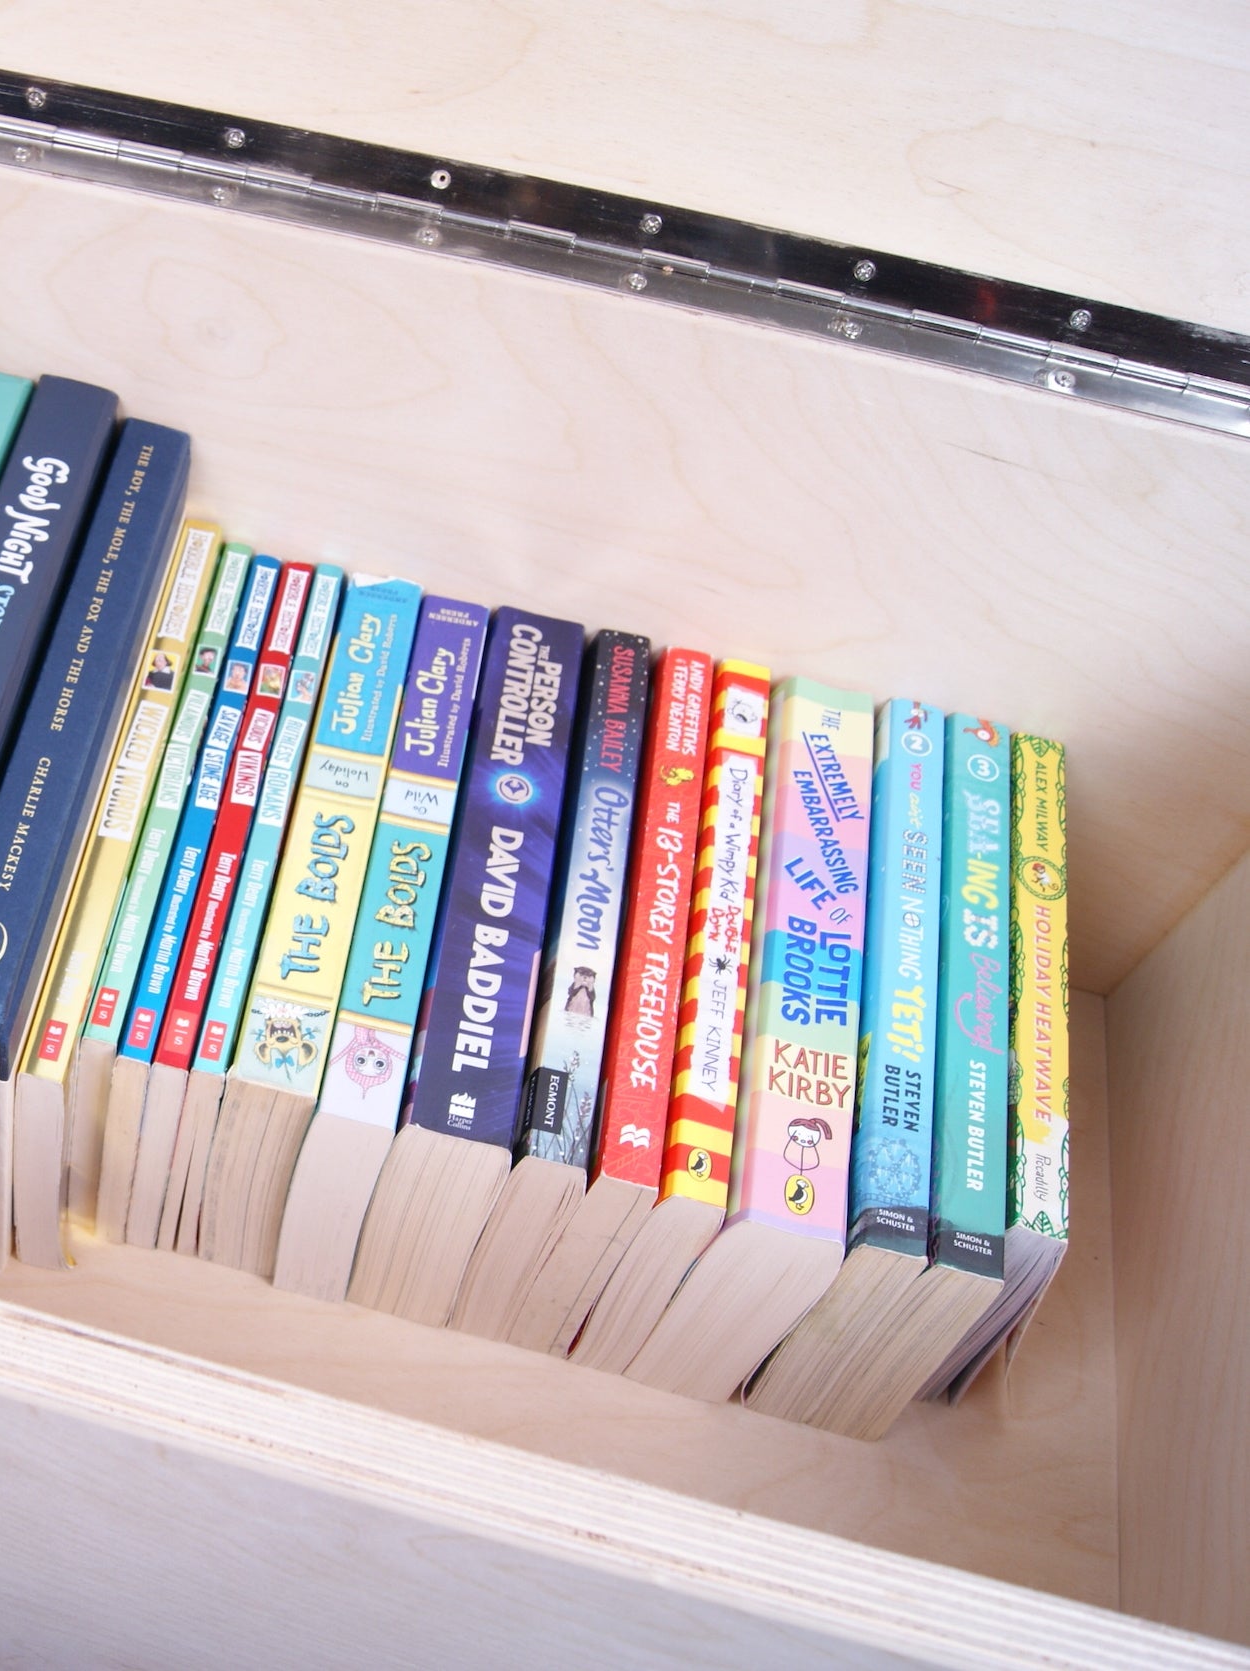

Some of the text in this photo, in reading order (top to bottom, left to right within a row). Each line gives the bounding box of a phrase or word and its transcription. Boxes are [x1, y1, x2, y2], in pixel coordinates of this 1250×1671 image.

[51, 445, 153, 732] THE BOY, THE MOLE, THE FOX AND THE HORSE
[330, 613, 381, 735] Julian Clary
[361, 687, 382, 742] Illustrated
[377, 649, 389, 677] David
[404, 648, 455, 756] Julian Clary
[490, 623, 543, 766] CONTROLLER
[525, 645, 563, 747] THE PERSON
[600, 645, 635, 773] SUSANNA BAILEY
[665, 666, 688, 752] TERRY DENTON
[682, 660, 705, 756] ANDY GRIFFITHS
[125, 707, 164, 760] WICKED
[199, 710, 238, 802] SAVAGE STONE AGE
[437, 713, 457, 768] Illustrated
[452, 674, 465, 704] David
[821, 709, 842, 731] THE
[21, 757, 51, 818] CHARLIE
[235, 755, 259, 797] VIKINGS
[261, 770, 290, 820] ROMANS
[320, 760, 368, 781] Holiday
[405, 789, 438, 806] Wild
[726, 767, 748, 808] Diary
[810, 733, 864, 822] EXTREMELY
[910, 763, 922, 790] YOU
[1035, 760, 1049, 852] ALEX MILWAY
[718, 833, 741, 877] Wimpy
[730, 808, 743, 821] of
[793, 769, 859, 895] EMBARRASSING
[279, 812, 355, 980] THE BOLDS
[719, 878, 739, 903] Kid
[783, 856, 854, 925] LIFE OF
[902, 829, 928, 894] SEEN
[184, 851, 238, 1001] Terry Deary Martin Brown
[362, 840, 432, 1007] THE BOLDS
[451, 826, 524, 1072] DAVID BADDIEL
[577, 869, 612, 950] Moon
[629, 801, 683, 1091] THE 13-STOREY TREEHOUSE
[898, 895, 926, 981] NOTHING
[963, 907, 999, 950] IS
[781, 915, 817, 1026] BROOKS
[815, 931, 852, 1026] LOTTIE
[701, 980, 728, 1092] JEFF KINNEY
[1033, 905, 1052, 1123] HOLIDAY HEATWAVE
[767, 1065, 851, 1110] KIRBY
[774, 1038, 849, 1081] KATIE
[882, 1064, 901, 1128] BUTLER
[447, 1120, 471, 1131] Collins
[448, 1114, 473, 1125] Harper
[544, 1074, 560, 1128] EGMONT
[904, 1070, 922, 1132] STEVEN
[966, 1059, 987, 1192] STEVEN BUTLER
[878, 1208, 905, 1221] SIMON
[1034, 1152, 1052, 1202] Piccadilly
[875, 1216, 916, 1232] SCHUSTER
